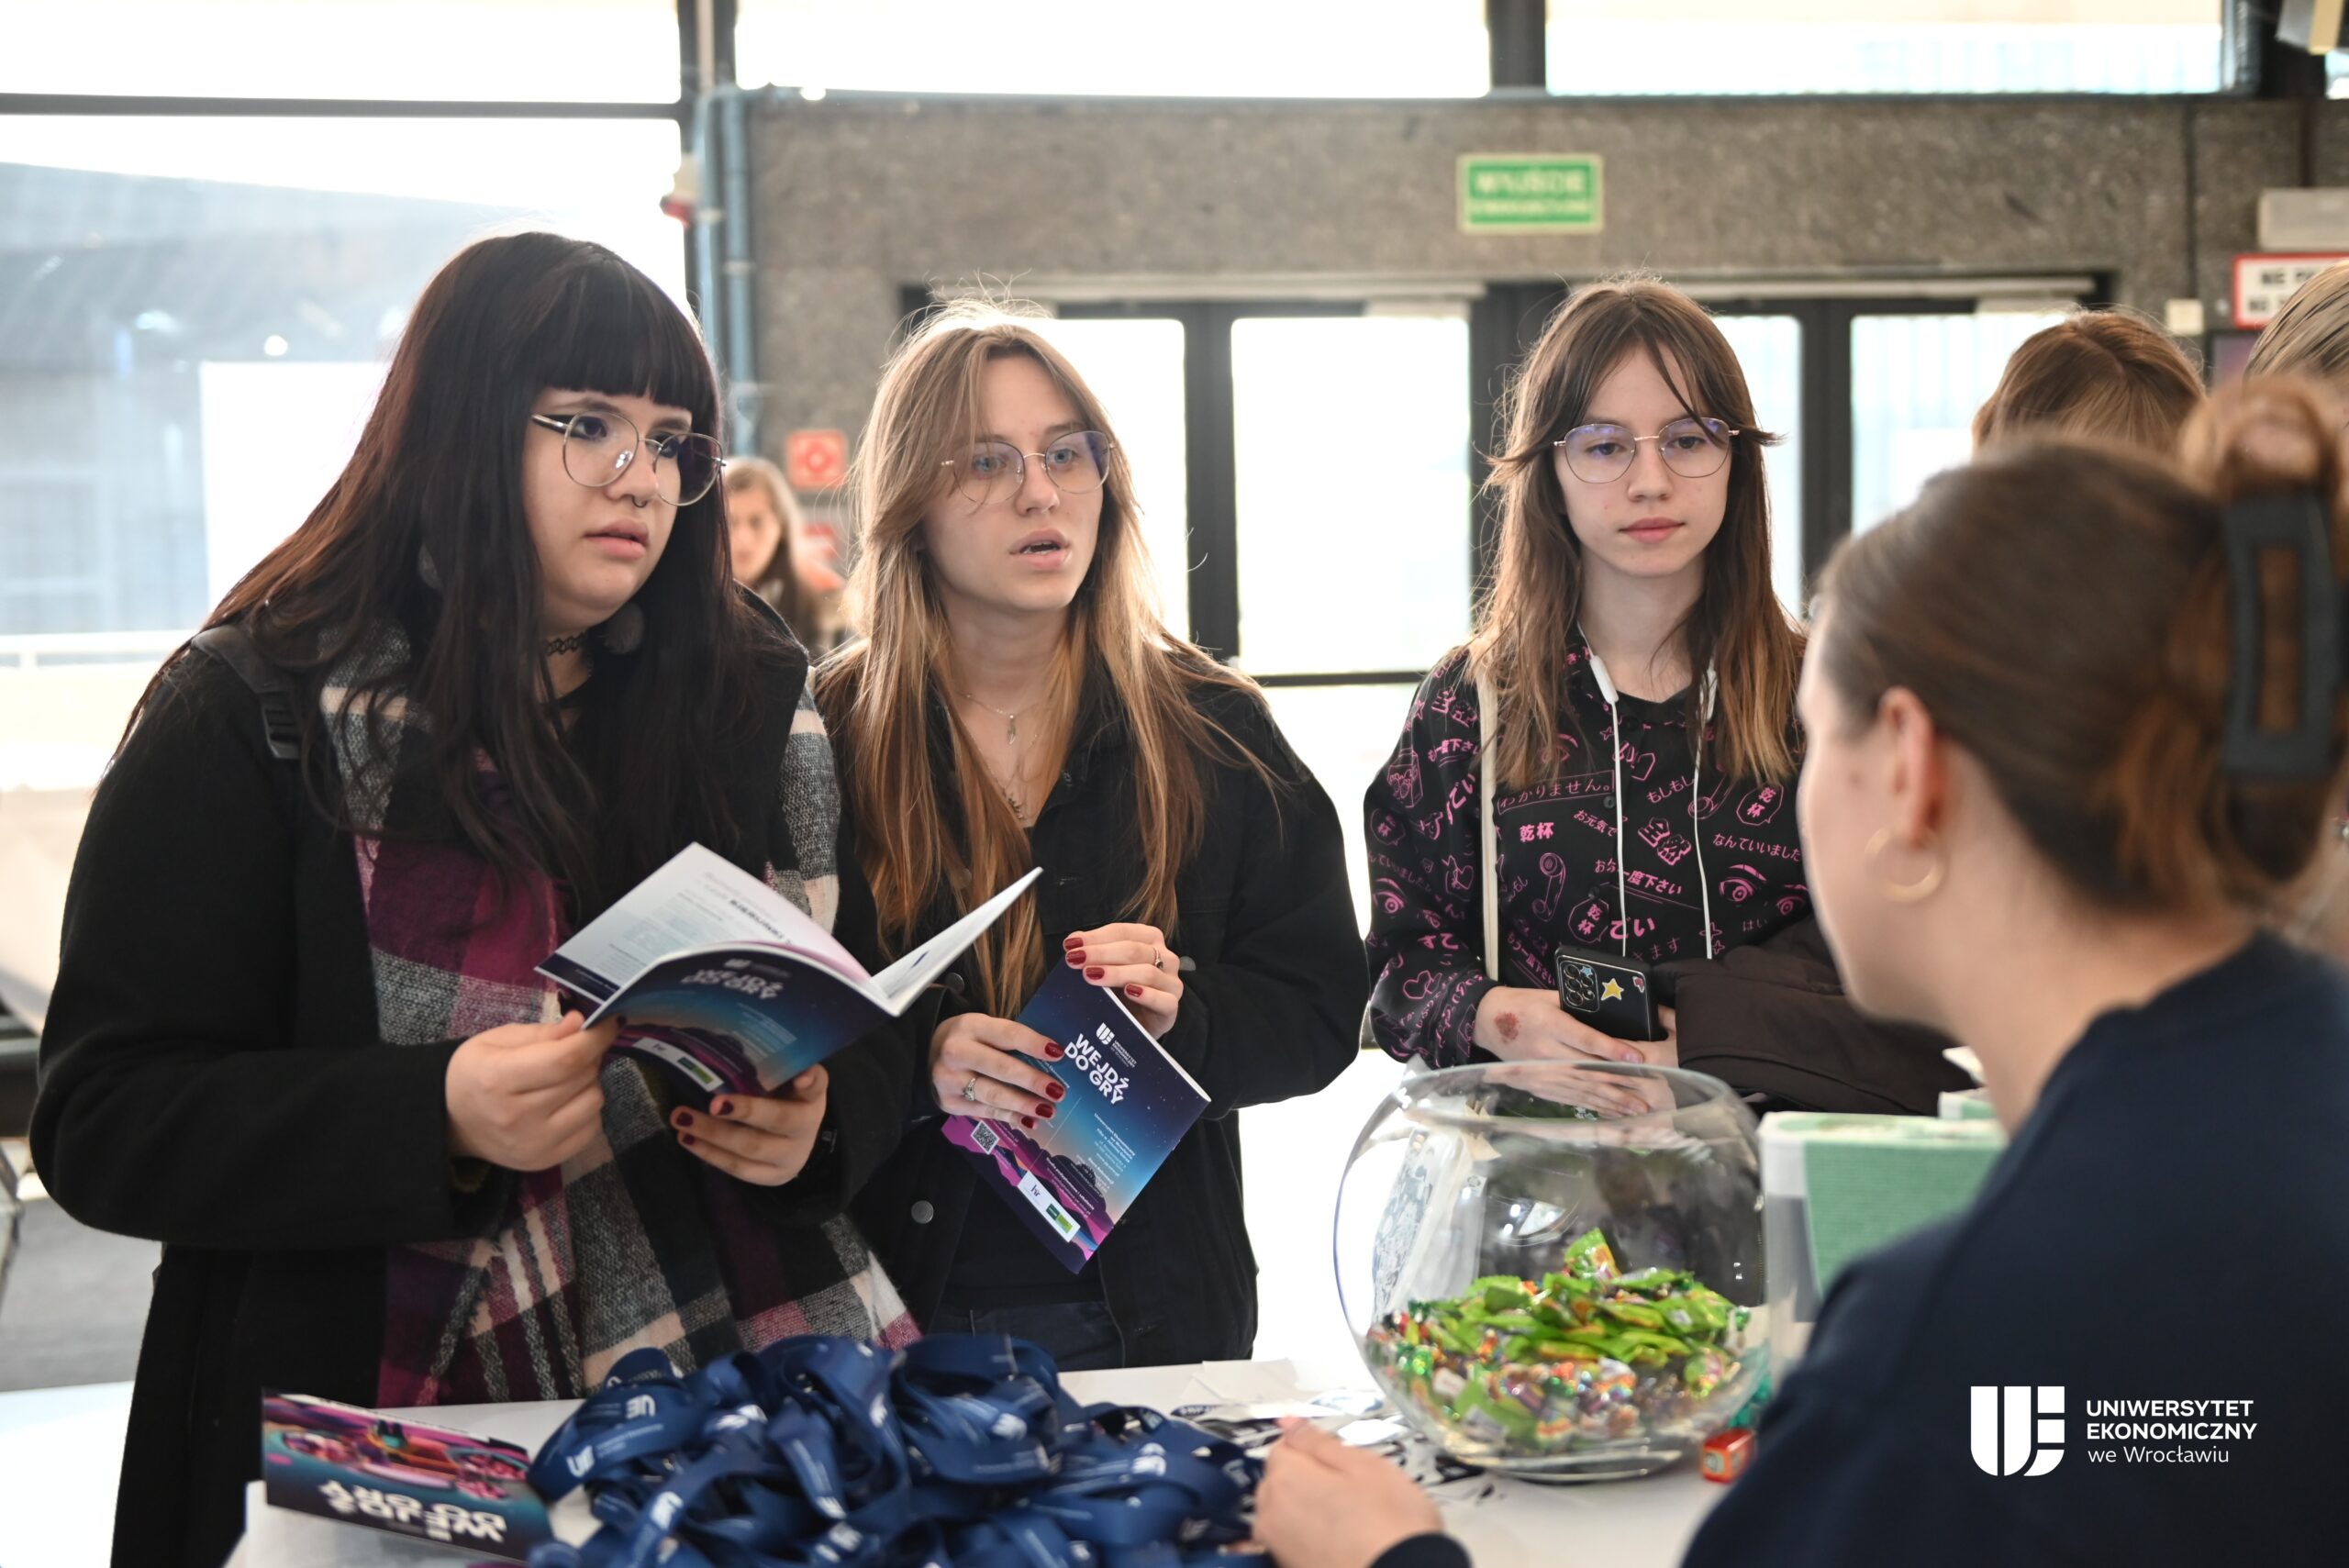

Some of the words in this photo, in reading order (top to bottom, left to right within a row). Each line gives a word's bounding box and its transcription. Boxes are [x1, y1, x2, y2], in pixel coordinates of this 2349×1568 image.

[1519, 822, 1554, 842] 乾杯
[1063, 1041, 1089, 1070] DO
[1089, 1071, 1123, 1104] GRY
[1075, 1033, 1130, 1095] WEJDŹ
